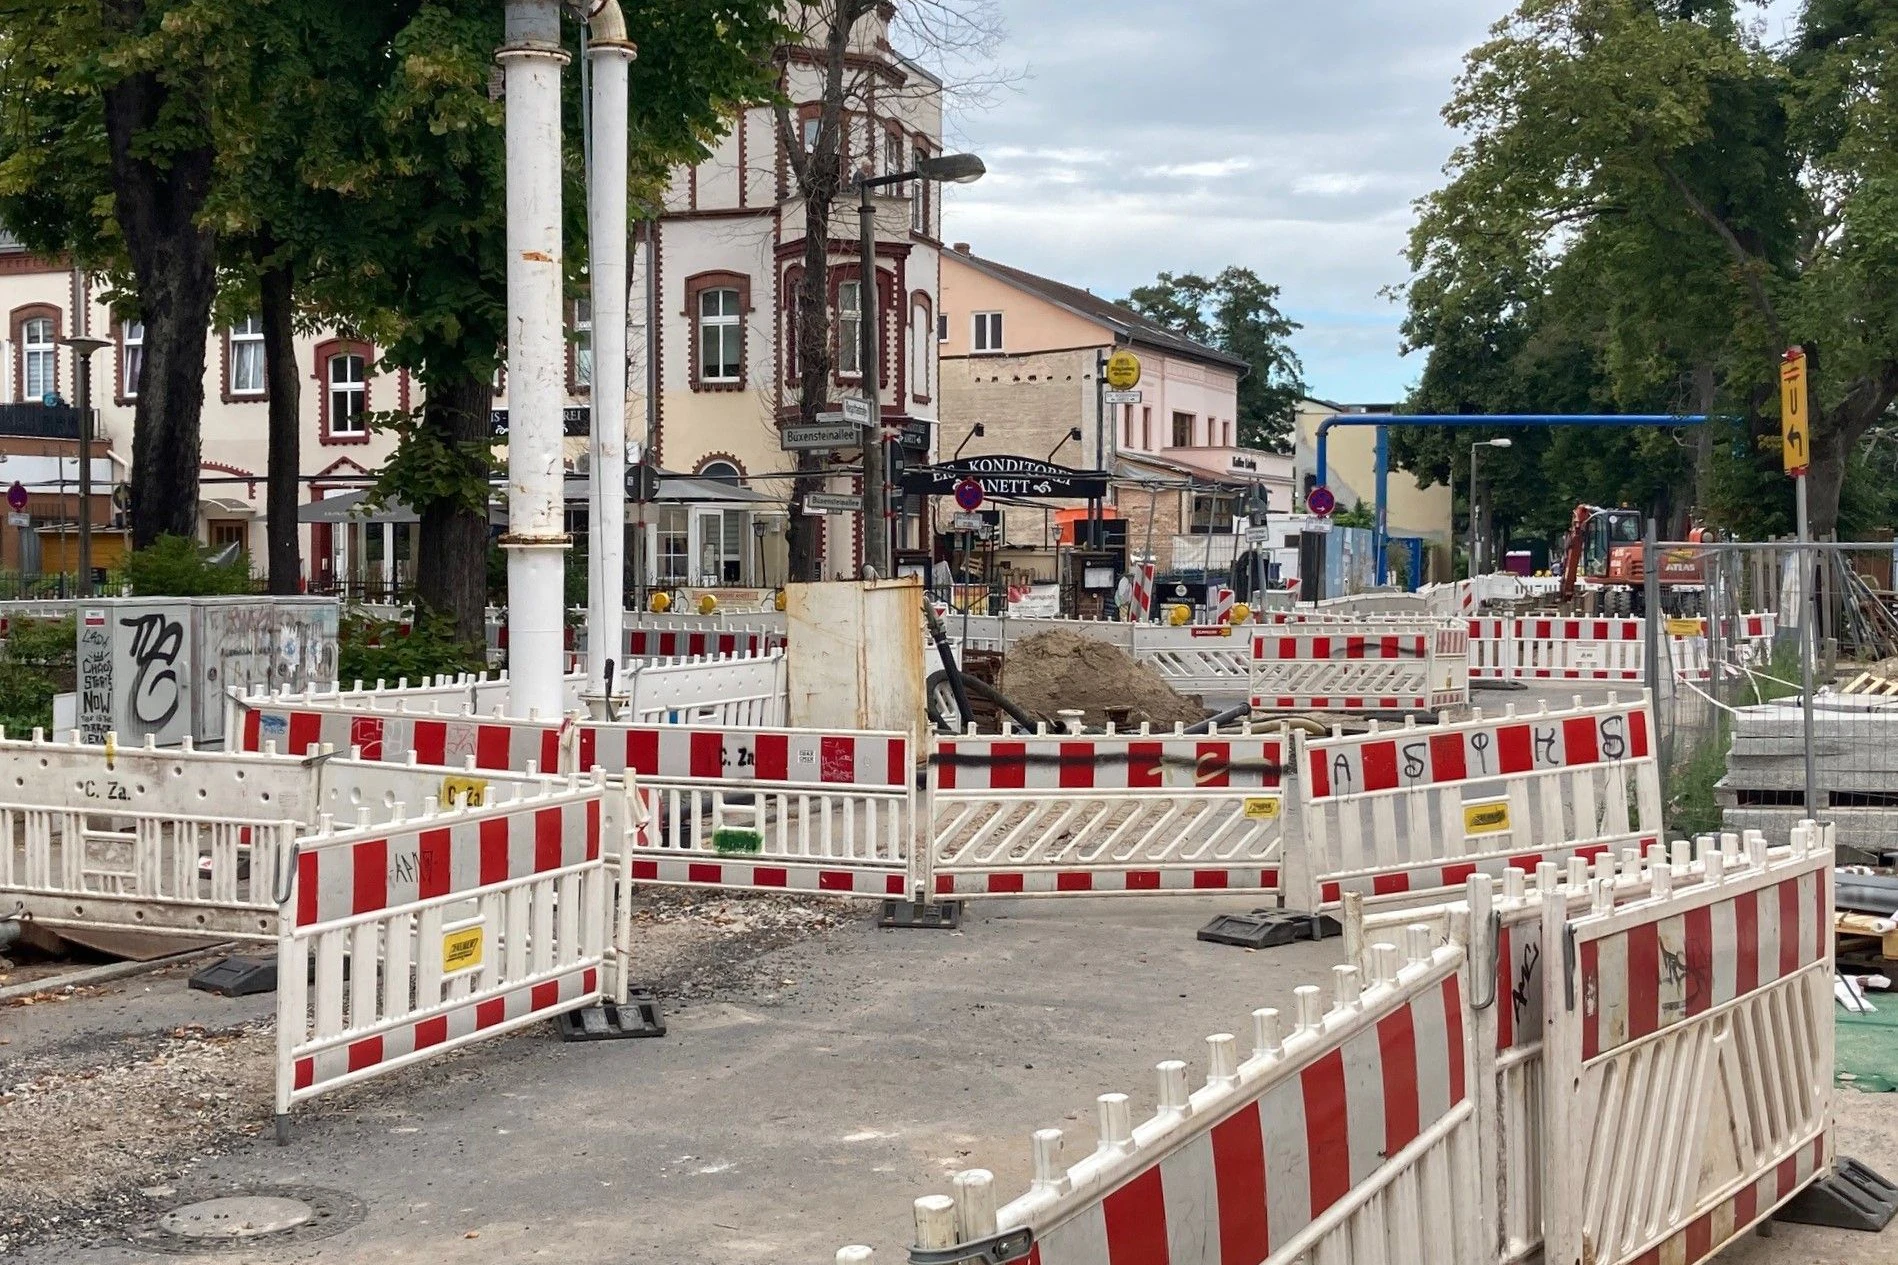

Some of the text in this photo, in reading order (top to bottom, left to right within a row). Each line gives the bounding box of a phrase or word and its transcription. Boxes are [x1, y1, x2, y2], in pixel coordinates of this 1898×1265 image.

[787, 429, 855, 443] Büxensteinallee
[1665, 563, 1696, 572] ATLAS
[83, 691, 110, 714] NOW
